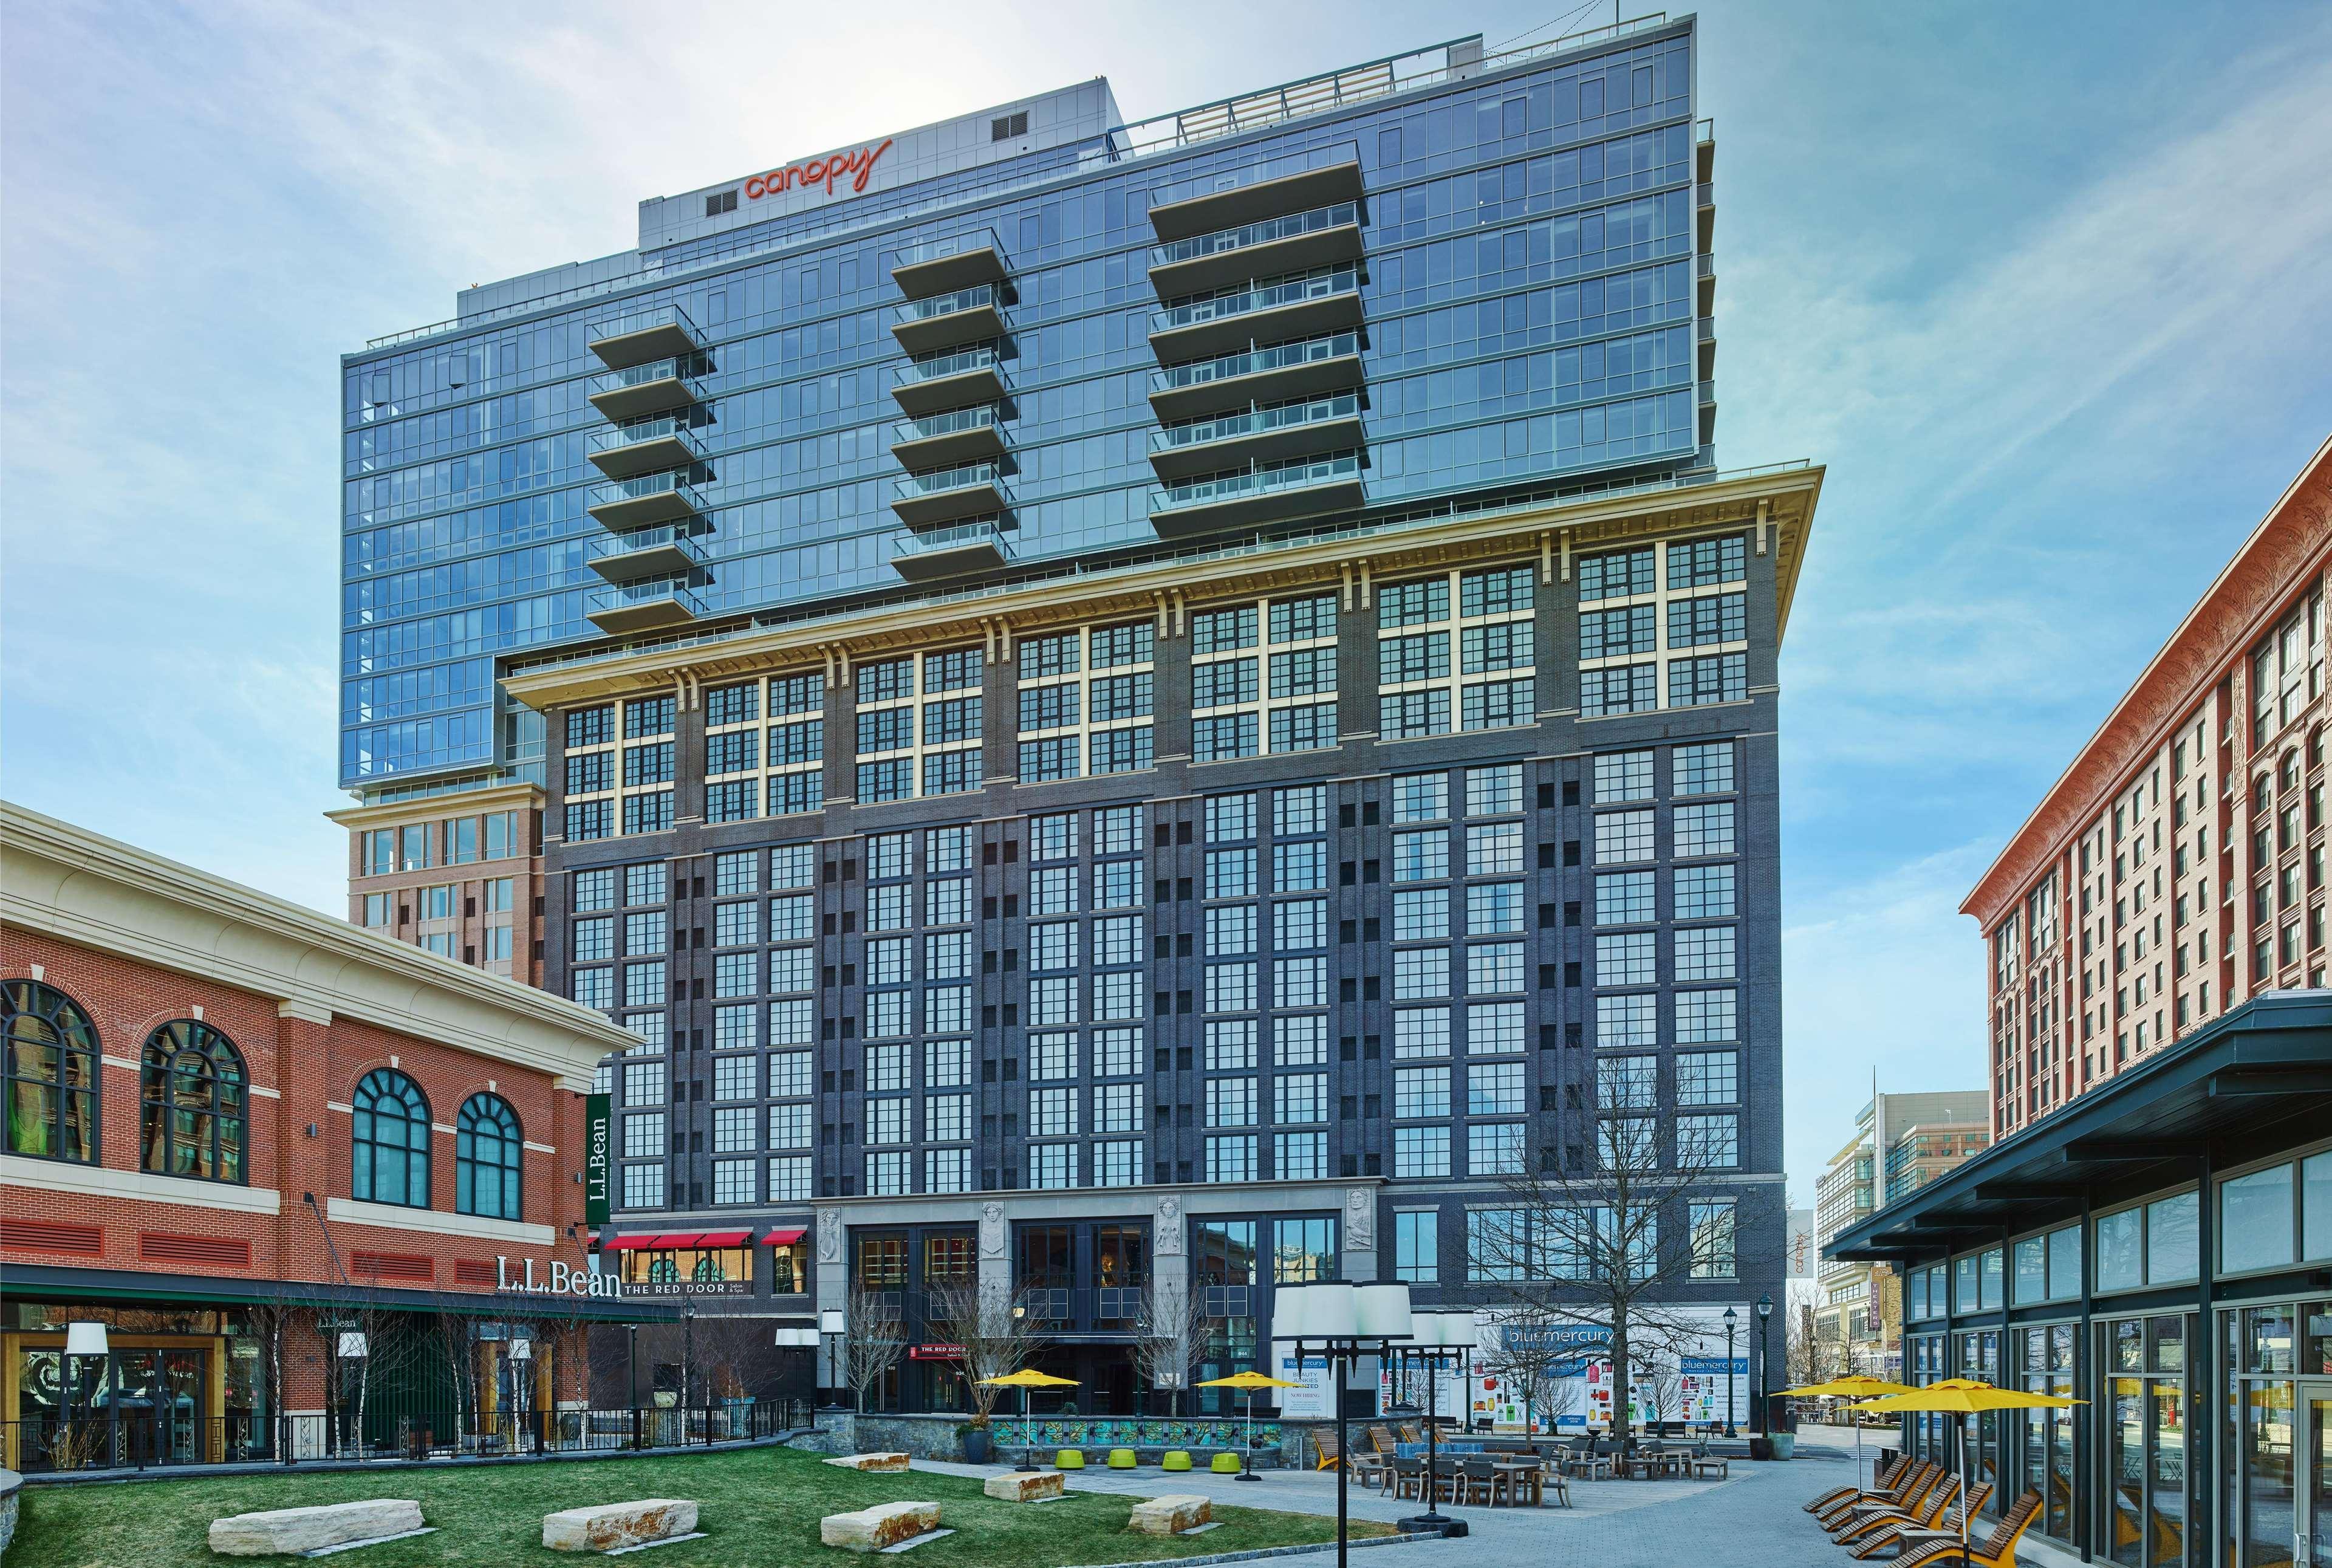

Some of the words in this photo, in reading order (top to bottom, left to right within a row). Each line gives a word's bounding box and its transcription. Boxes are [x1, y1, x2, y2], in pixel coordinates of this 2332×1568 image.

[745, 138, 893, 199] canopy
[589, 1117, 606, 1201] L.L.Bean
[496, 1256, 622, 1298] L.L.Bean
[624, 1286, 649, 1294] THE
[655, 1285, 680, 1293] RED
[686, 1284, 725, 1293] DOOR
[1510, 1330, 1615, 1344] bluemercury
[1682, 1360, 1745, 1371] bluemercry
